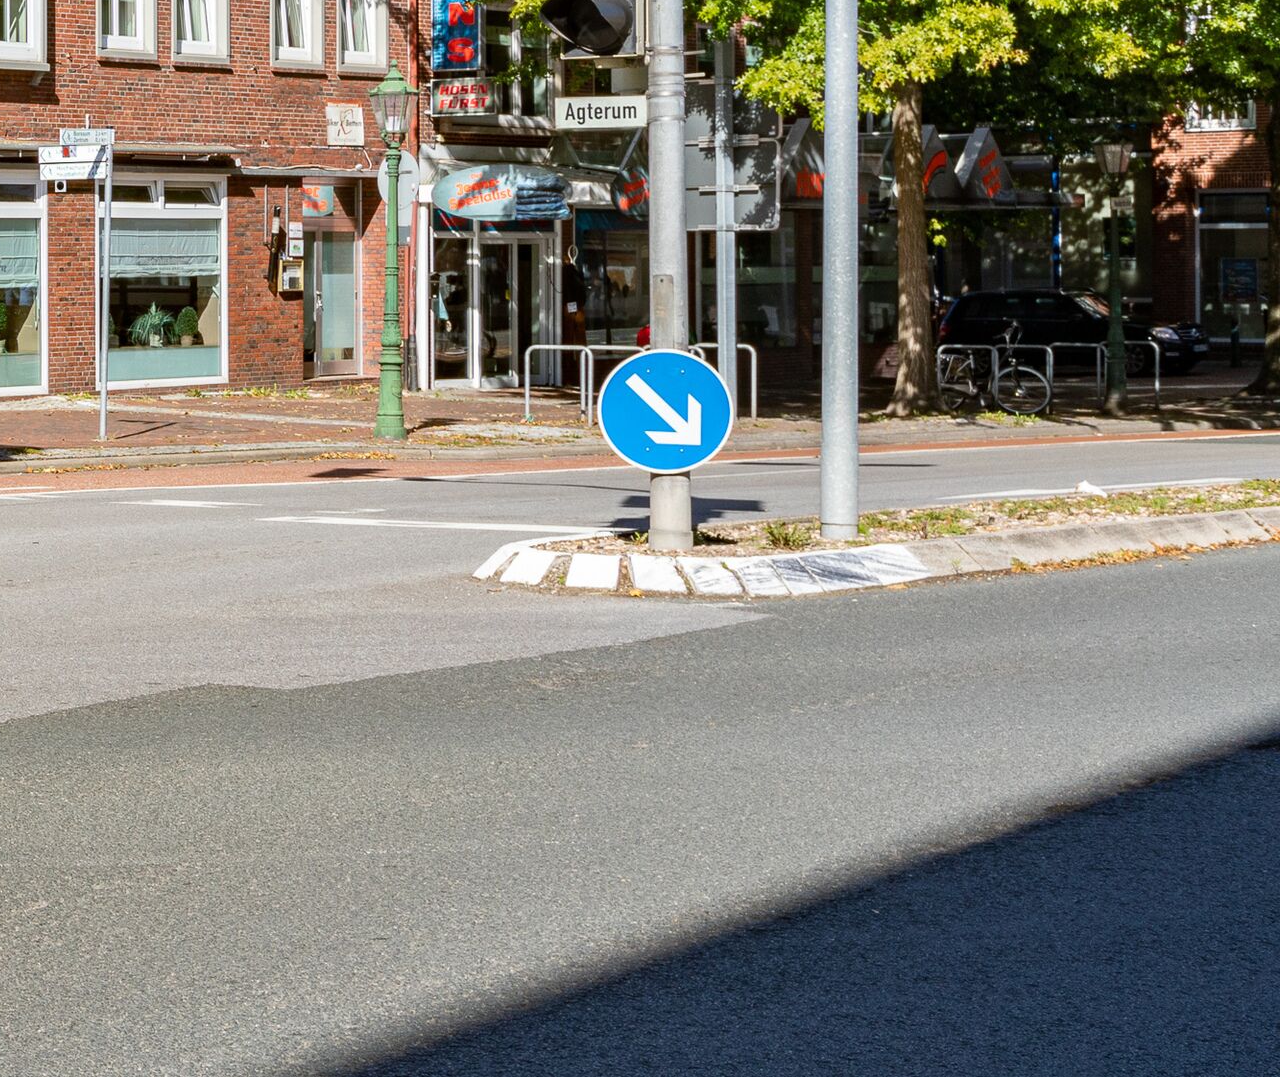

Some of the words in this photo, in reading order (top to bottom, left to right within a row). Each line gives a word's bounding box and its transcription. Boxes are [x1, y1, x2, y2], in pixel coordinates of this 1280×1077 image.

[439, 84, 488, 95] HOSEN
[439, 96, 489, 109] FÜRST
[565, 102, 637, 125] Agterum
[448, 188, 513, 210] Spezialist
